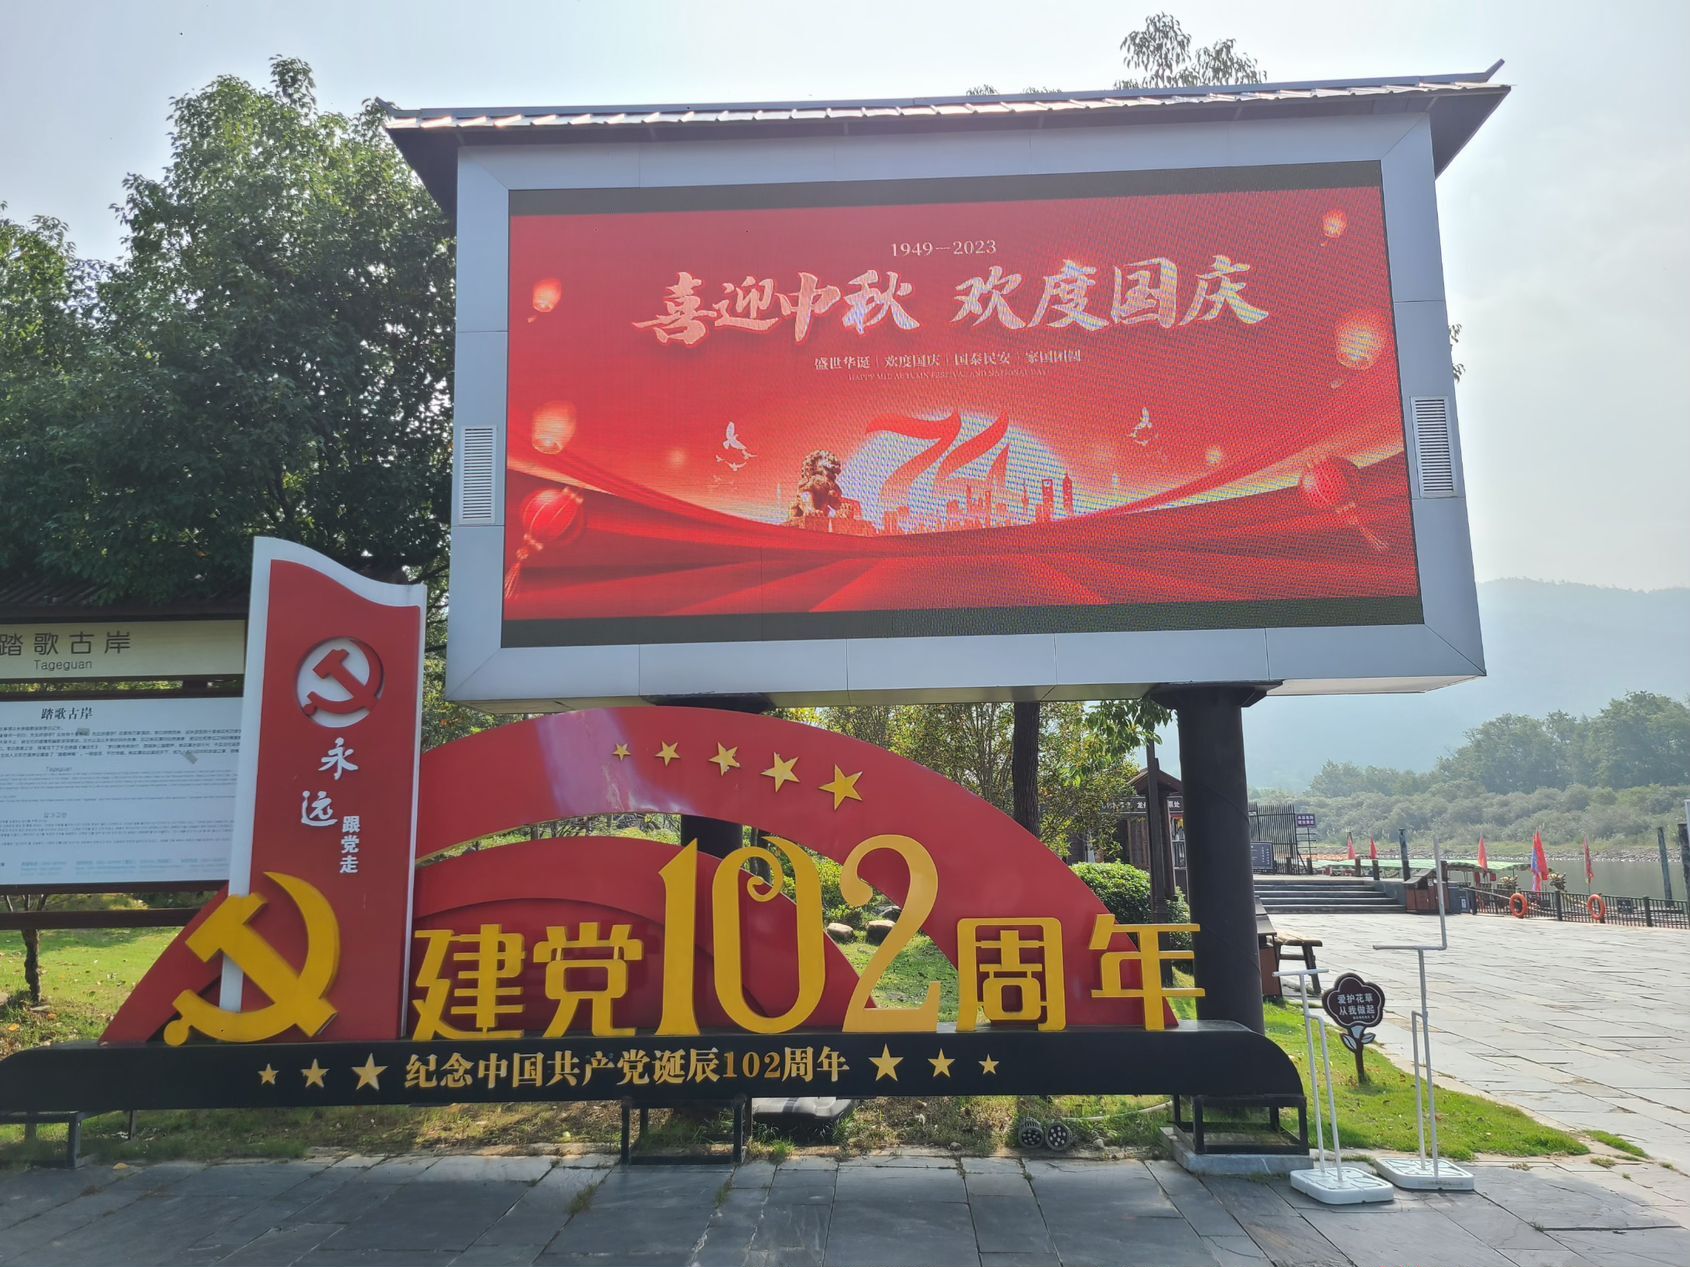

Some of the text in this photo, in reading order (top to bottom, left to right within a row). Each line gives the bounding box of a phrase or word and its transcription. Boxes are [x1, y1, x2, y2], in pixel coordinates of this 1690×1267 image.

[632, 254, 1270, 346] 喜迎中秋 欢度国庆
[0, 631, 131, 656] 踏歌古岸
[34, 659, 92, 672] Tageguan
[41, 706, 93, 720] 踏歌古岸
[301, 737, 359, 828] 永远
[340, 815, 361, 874] 跟党走
[412, 834, 1205, 1042] 建党102周年
[404, 1046, 850, 1090] 纪念中国共产党诞辰102周年
